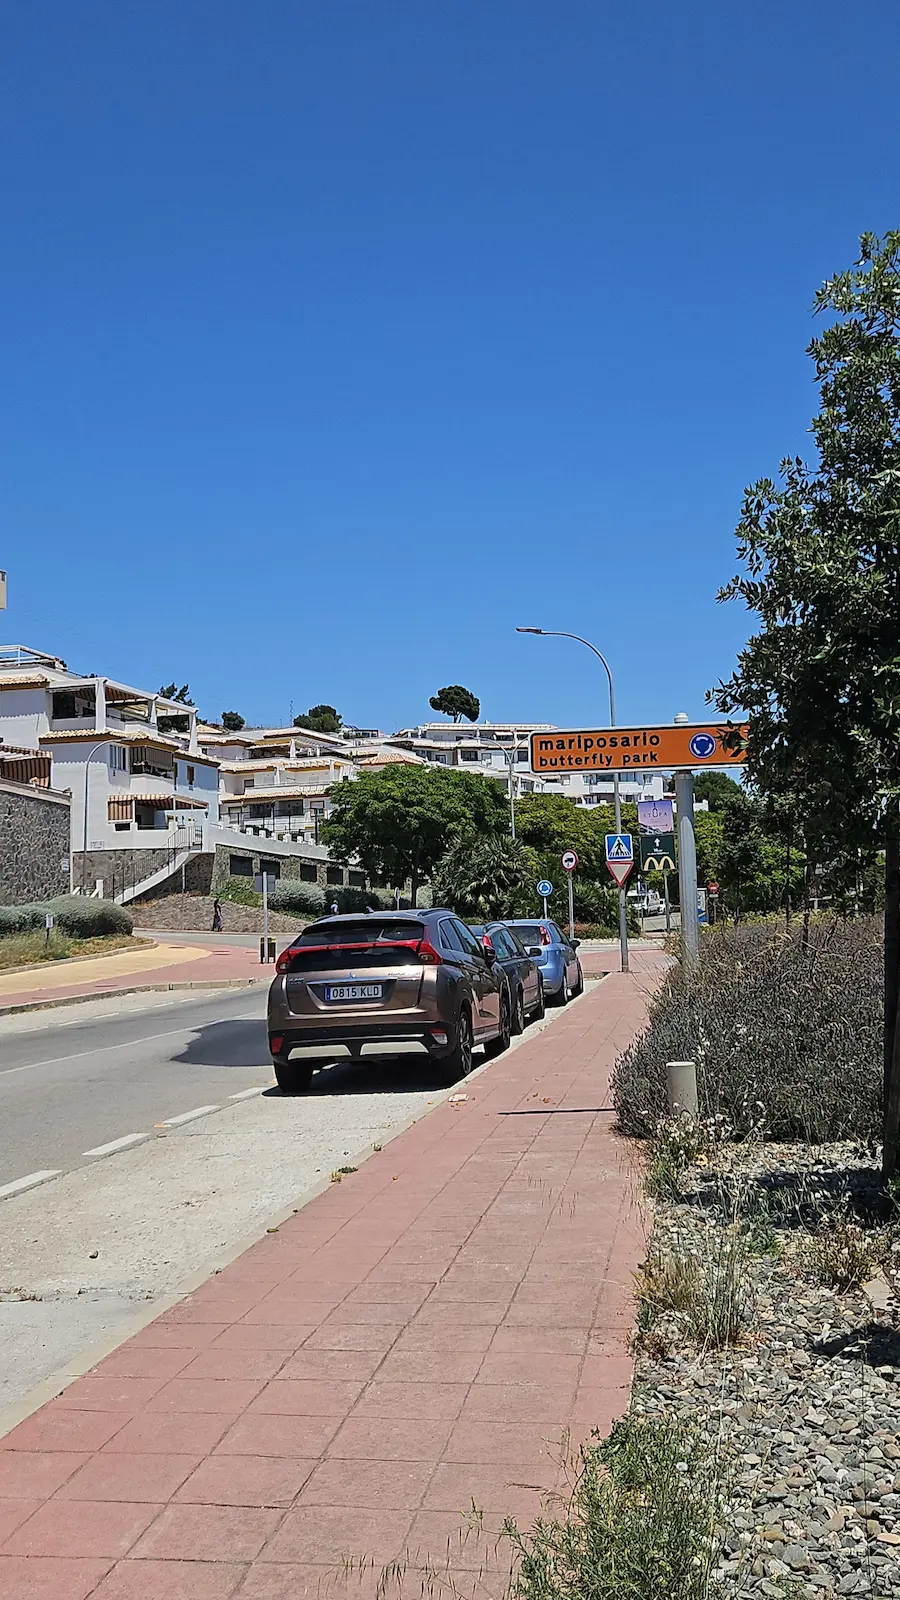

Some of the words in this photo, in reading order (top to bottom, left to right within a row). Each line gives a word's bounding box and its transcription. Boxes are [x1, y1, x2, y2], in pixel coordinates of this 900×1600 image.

[539, 732, 660, 752] mariposario
[539, 753, 613, 767] butterfly
[622, 751, 658, 766] park
[332, 987, 357, 998] 0815
[360, 986, 379, 997] KLD
